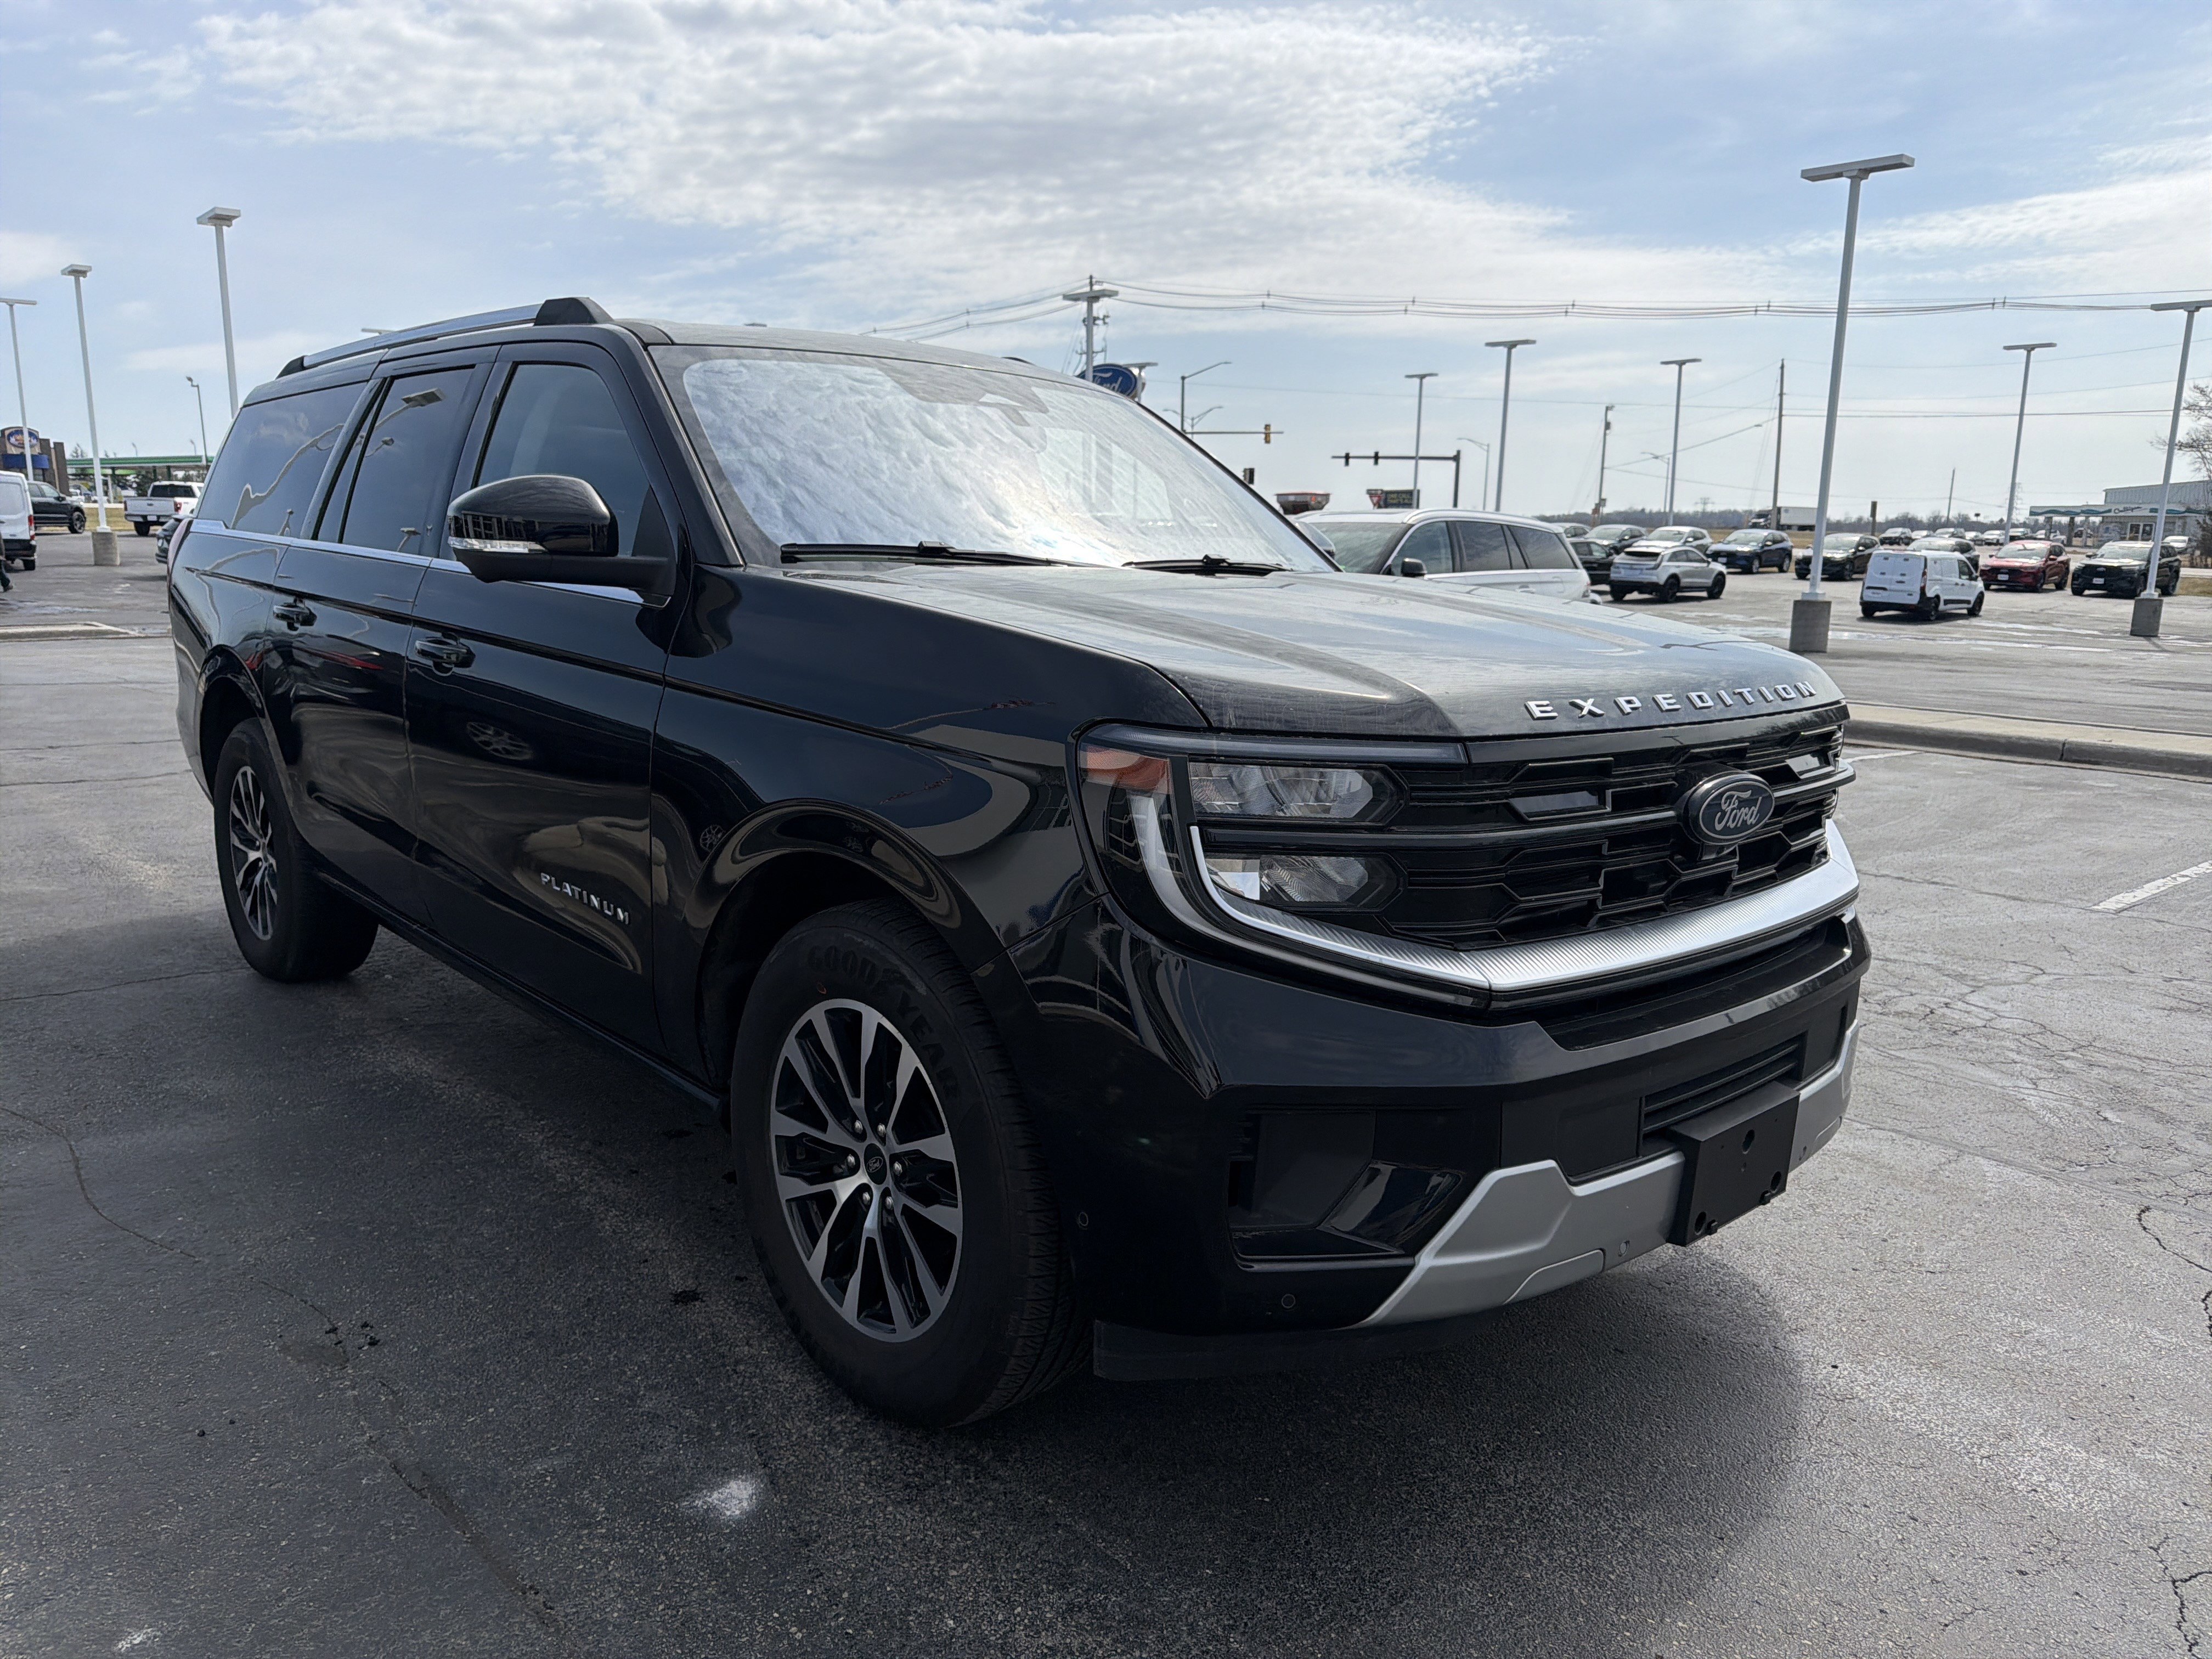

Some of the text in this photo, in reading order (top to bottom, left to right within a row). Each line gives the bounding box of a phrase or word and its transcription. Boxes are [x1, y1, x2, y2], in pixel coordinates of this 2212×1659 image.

[1093, 373, 1123, 392] Fd
[1524, 681, 1816, 720] EXPEDITION
[1715, 790, 1762, 831] Ford
[540, 872, 629, 924] PLATINUM
